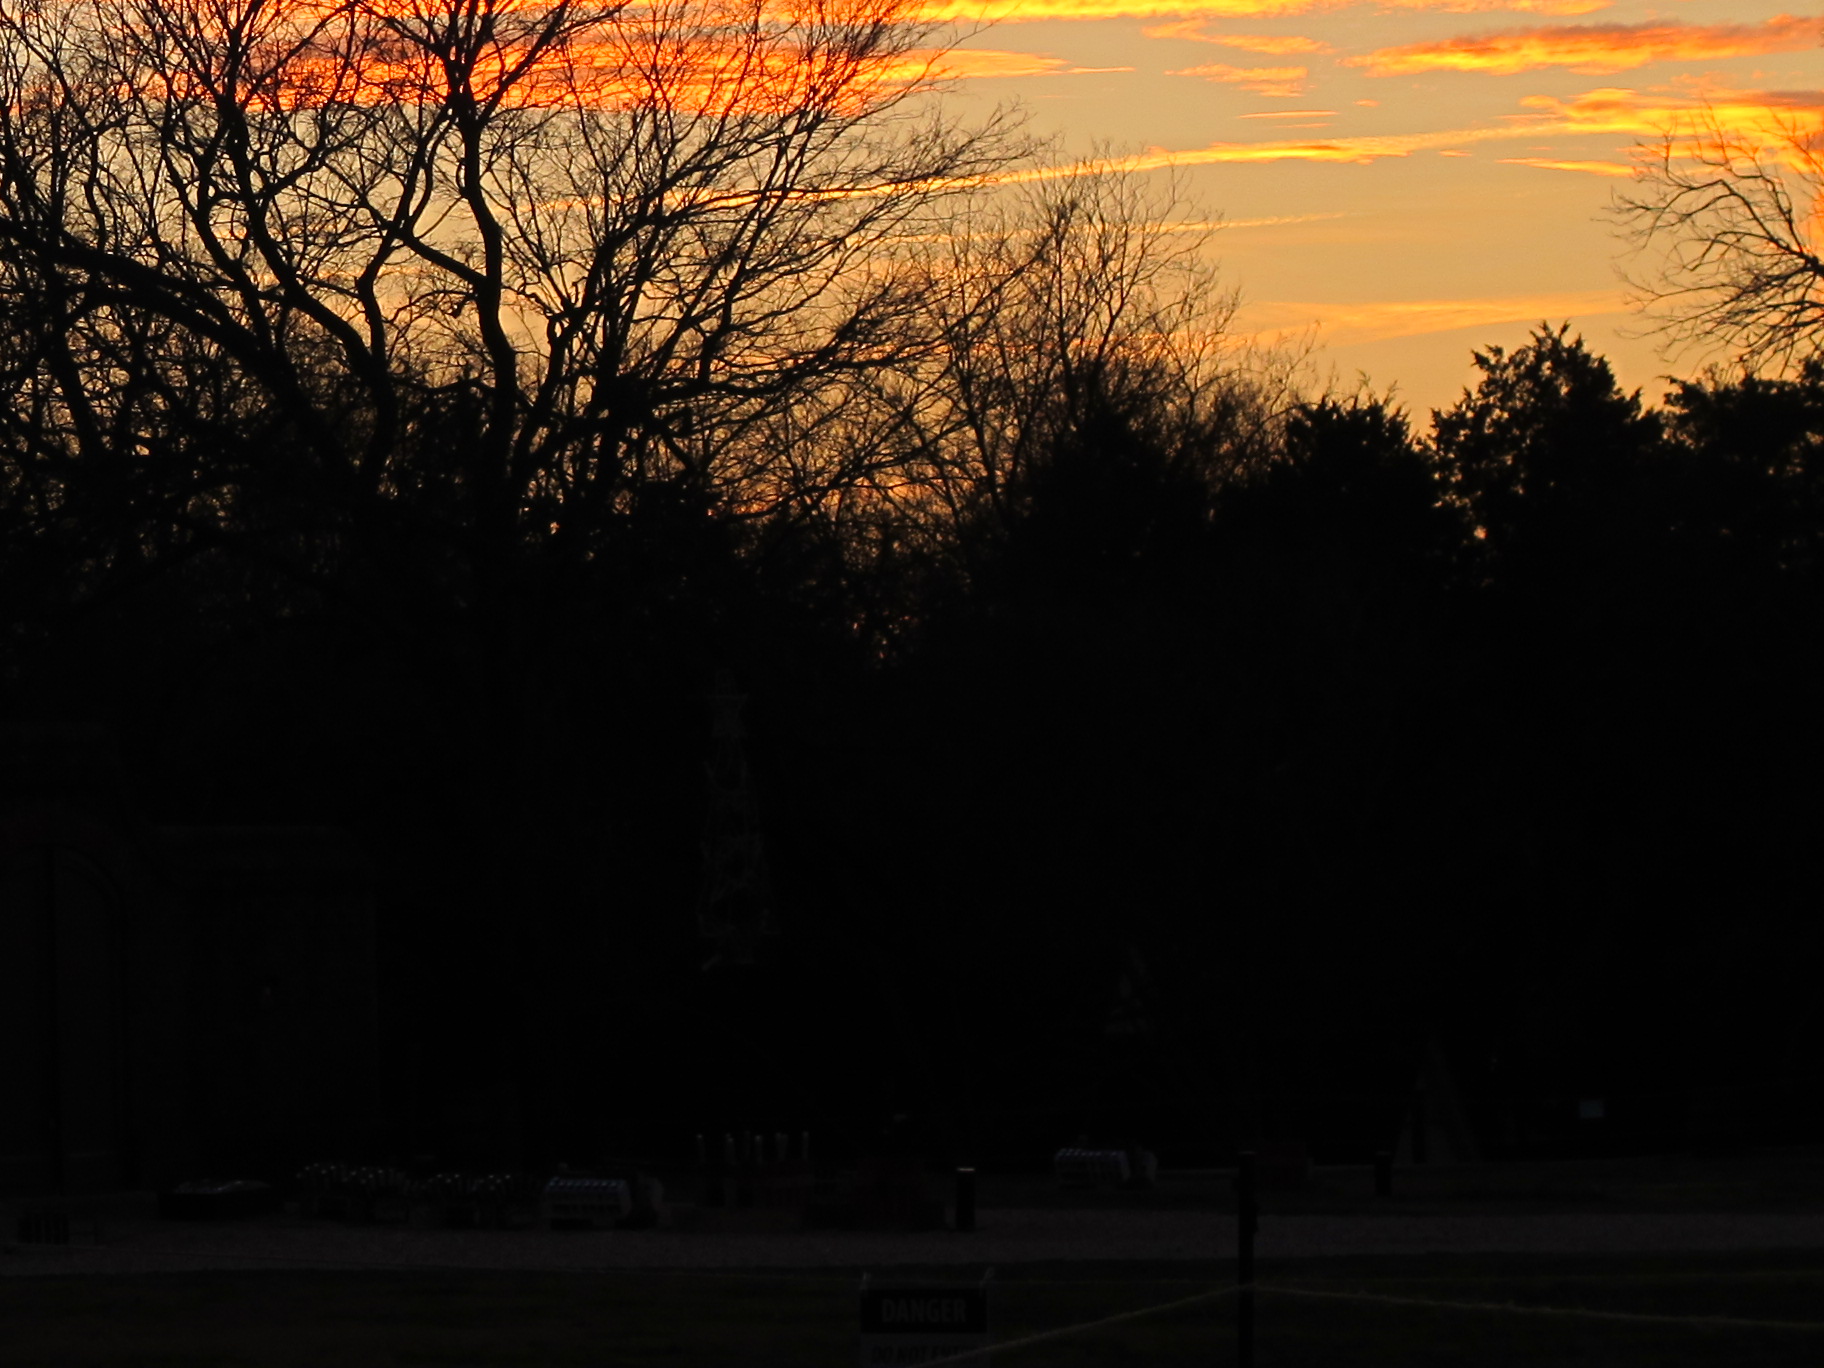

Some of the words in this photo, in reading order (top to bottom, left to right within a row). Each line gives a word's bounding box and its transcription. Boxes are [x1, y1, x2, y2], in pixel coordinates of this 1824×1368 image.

[881, 1298, 967, 1323] DANGER
[871, 1344, 893, 1364] DO
[896, 1344, 928, 1364] NOT
